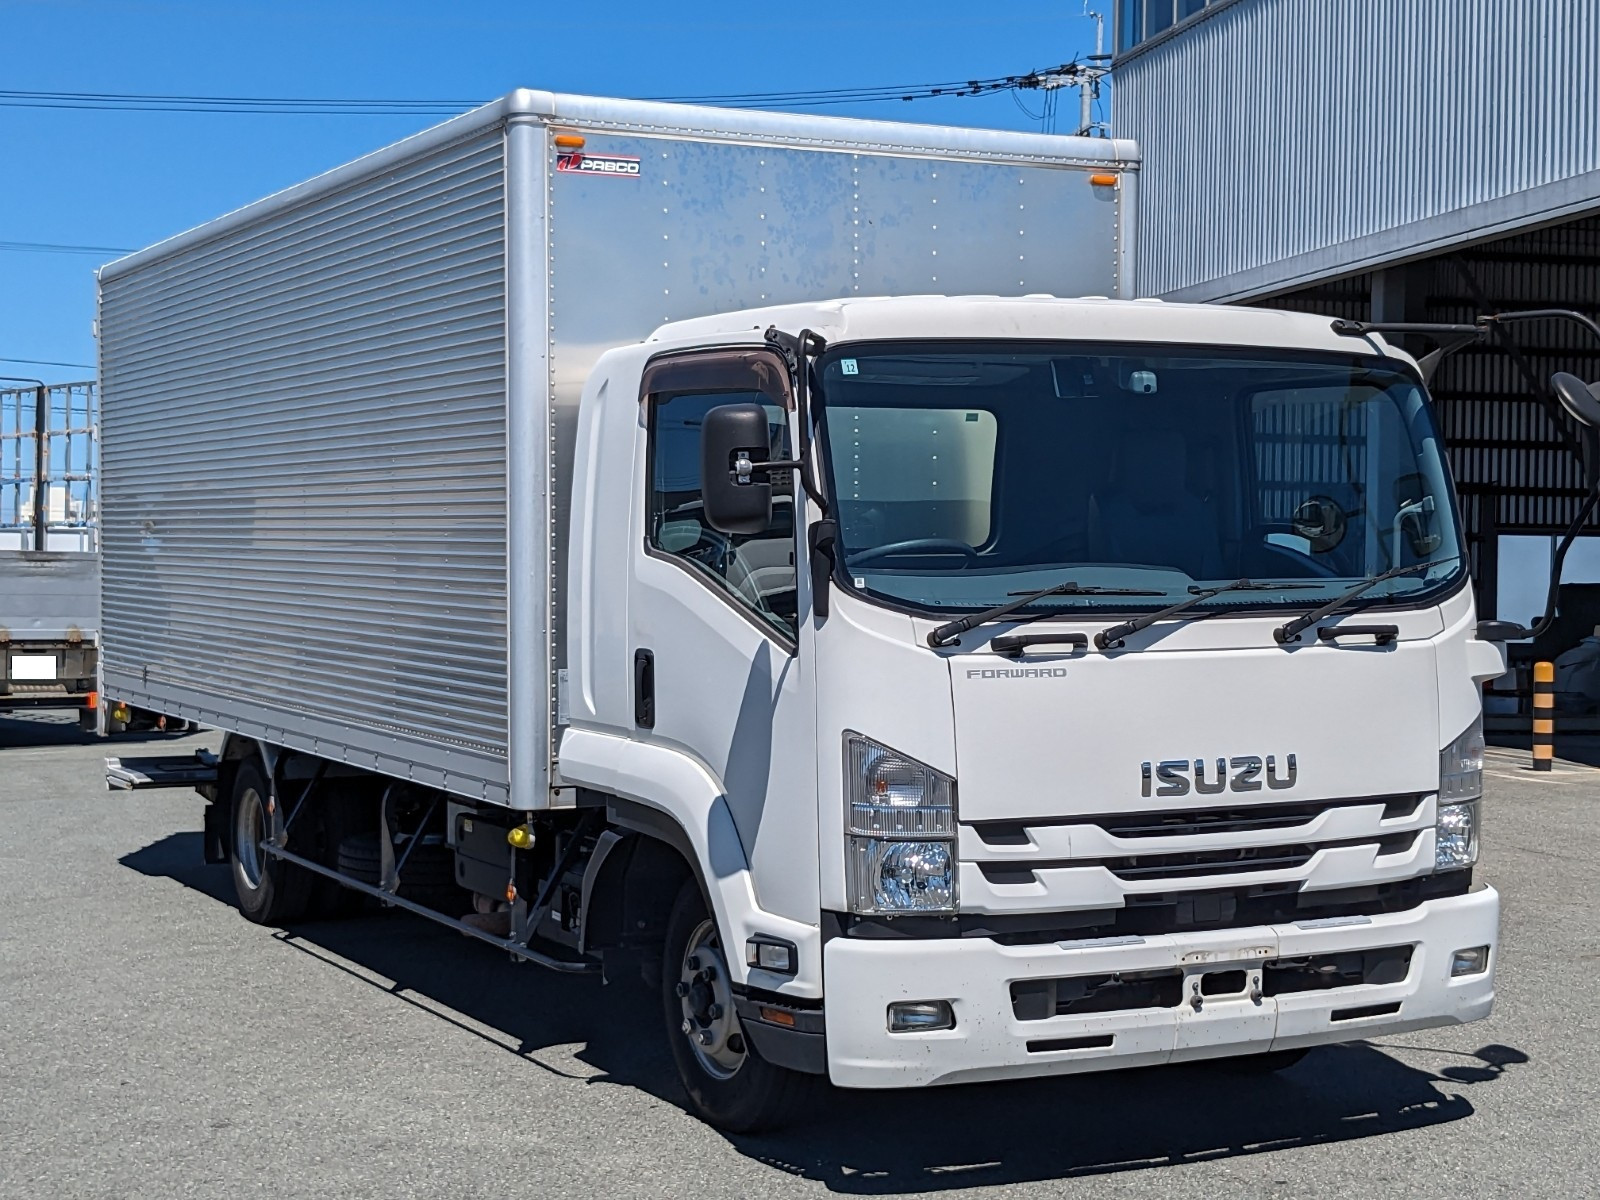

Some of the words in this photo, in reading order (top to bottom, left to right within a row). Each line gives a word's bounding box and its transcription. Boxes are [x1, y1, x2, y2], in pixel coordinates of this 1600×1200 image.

[580, 158, 640, 174] PABCO
[846, 363, 856, 373] 12
[966, 667, 1068, 680] FORWARD
[1140, 753, 1298, 798] ISUZU
